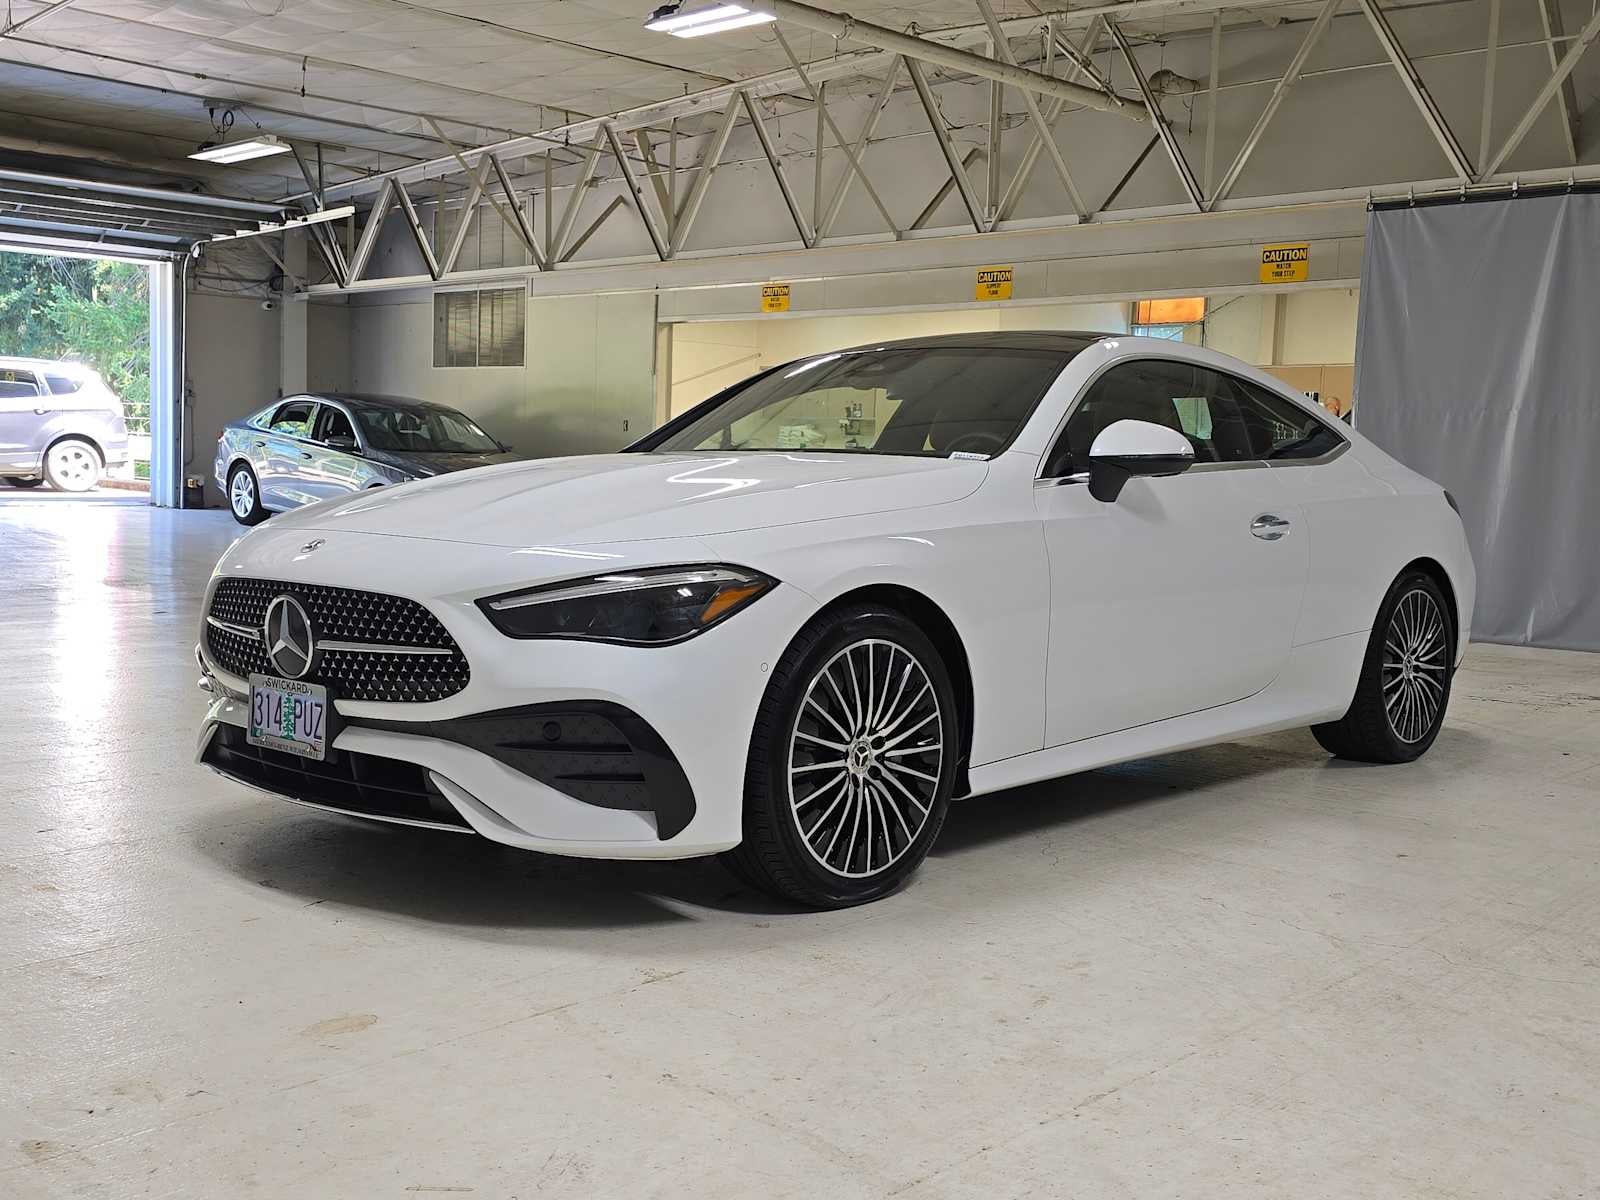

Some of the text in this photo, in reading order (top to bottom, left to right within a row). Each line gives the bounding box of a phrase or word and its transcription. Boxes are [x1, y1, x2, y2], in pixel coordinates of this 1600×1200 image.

[1263, 249, 1307, 262] CAUTION
[978, 271, 1011, 282] CAUTION
[762, 286, 790, 297] CAUTION
[266, 677, 308, 694] SWICKARD
[255, 692, 323, 740] 314 PUZ
